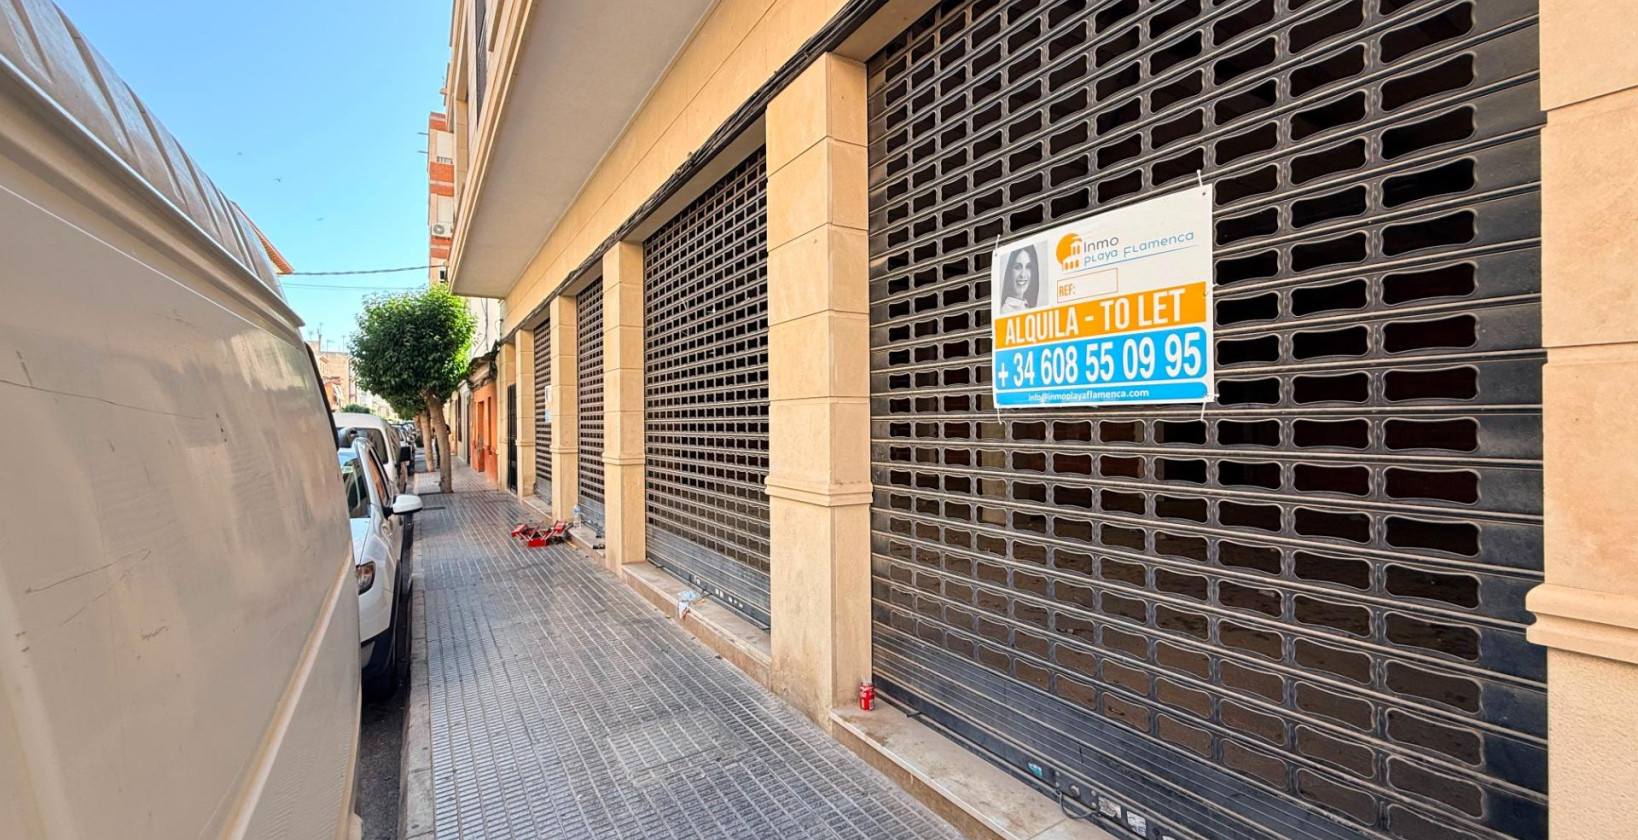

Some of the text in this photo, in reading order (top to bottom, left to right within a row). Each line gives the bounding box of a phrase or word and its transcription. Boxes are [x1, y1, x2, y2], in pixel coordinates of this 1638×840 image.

[1083, 236, 1119, 253] Inmo
[1059, 285, 1076, 296] REF:
[1005, 307, 1079, 345] ALQUILA
[1100, 299, 1130, 331] TO
[1138, 289, 1186, 327] LET
[1013, 351, 1035, 387] 34
[1041, 345, 1078, 385] 608
[1085, 342, 1115, 382] 55
[1123, 337, 1156, 380] 09
[1165, 332, 1201, 378] 95
